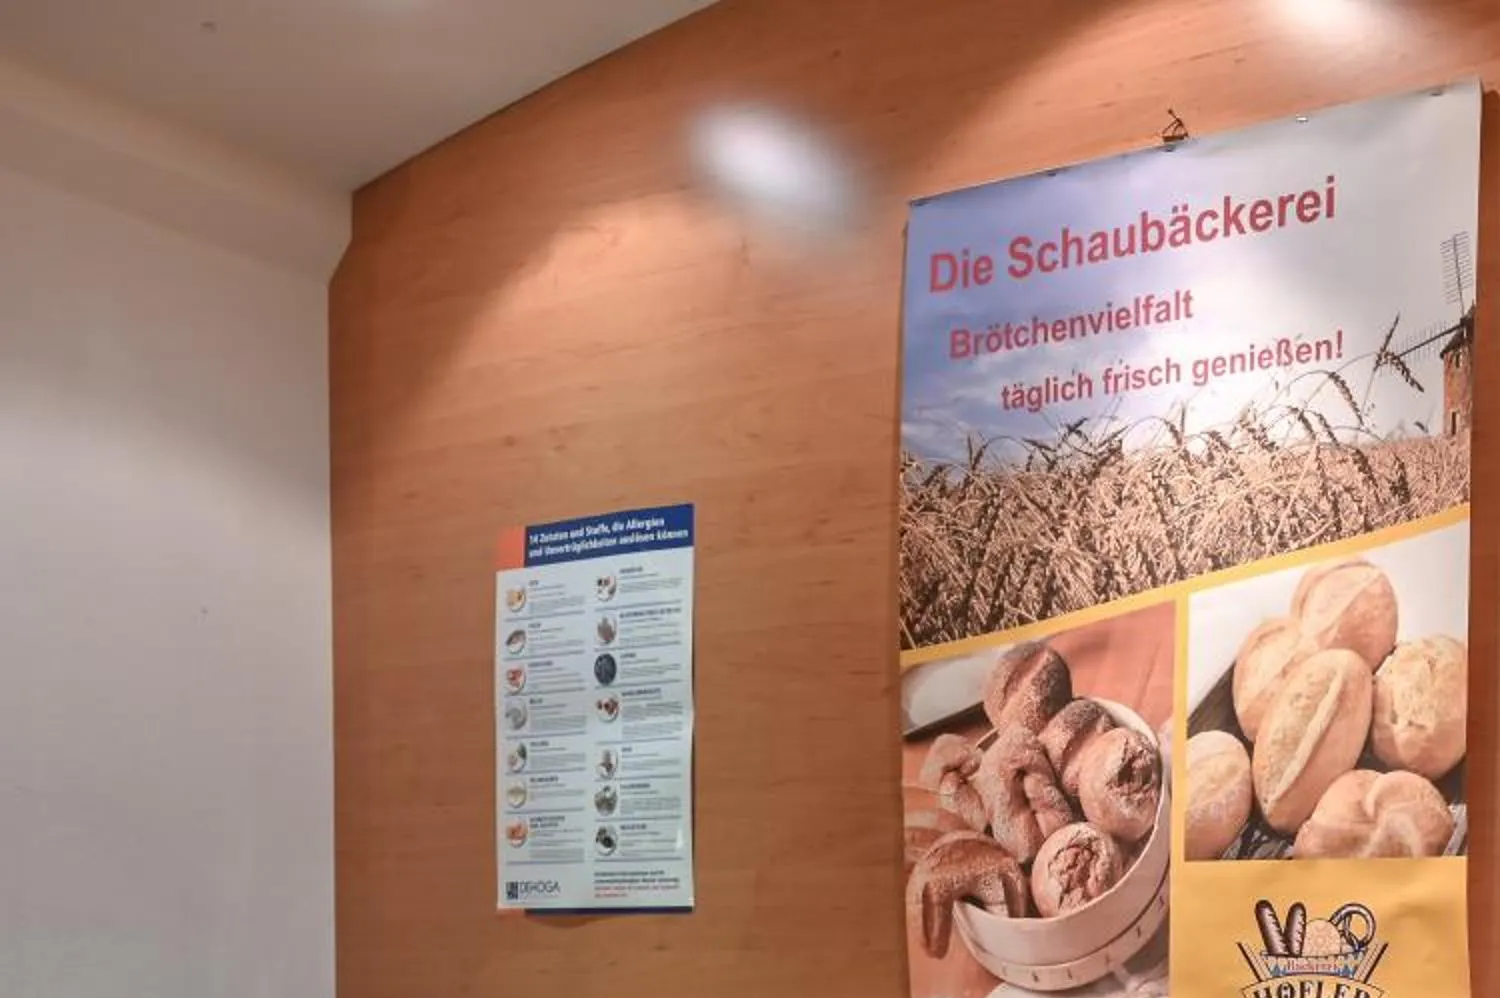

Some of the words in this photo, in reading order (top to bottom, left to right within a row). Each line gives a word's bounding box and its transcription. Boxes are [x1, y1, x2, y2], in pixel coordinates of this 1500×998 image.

[929, 247, 993, 293] Die
[1007, 175, 1337, 280] Schaubäckerei
[949, 289, 1194, 361] Brötchenvielfalt
[1001, 366, 1093, 414] täglich
[1102, 354, 1182, 396] frisch
[1191, 330, 1345, 388] genießen!
[528, 547, 543, 559] und
[570, 527, 584, 539] und
[611, 522, 625, 533] die
